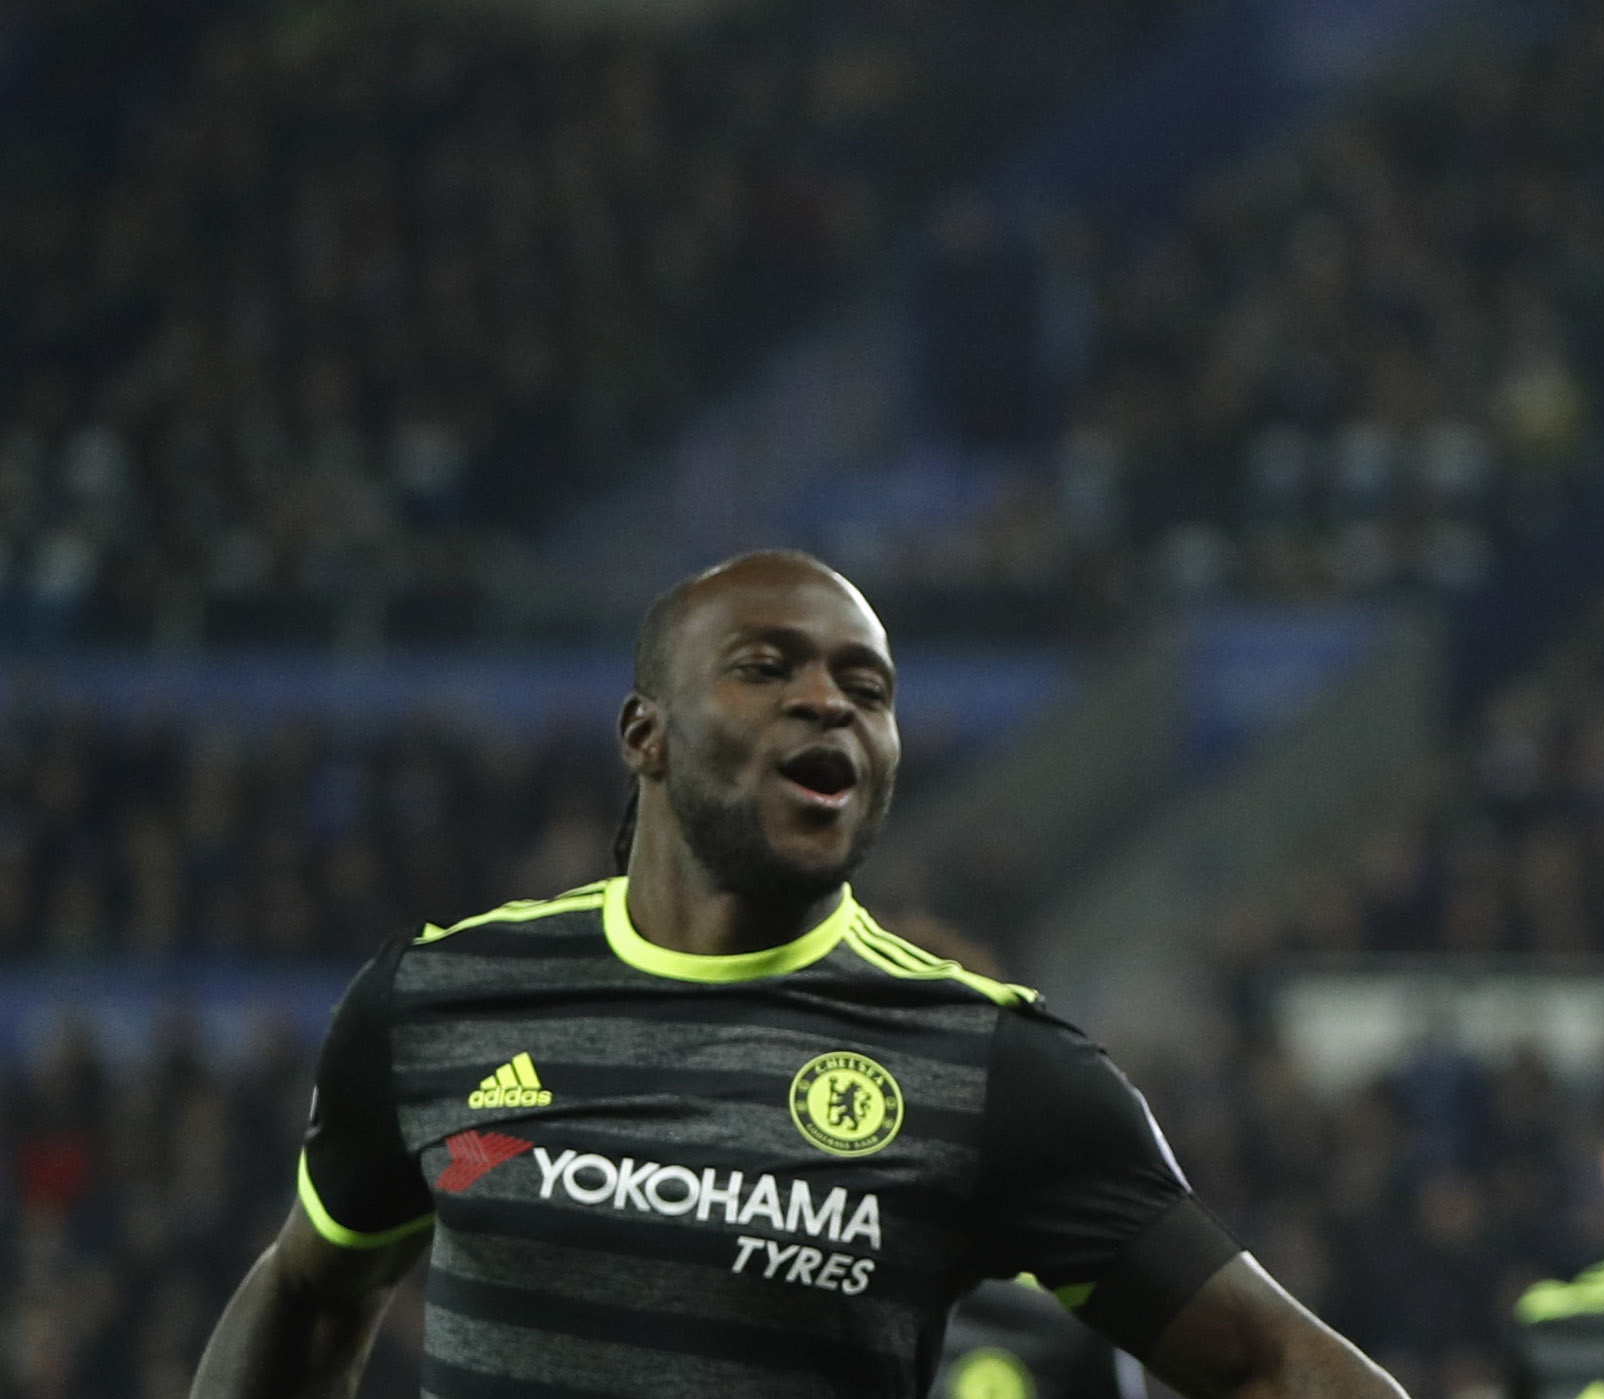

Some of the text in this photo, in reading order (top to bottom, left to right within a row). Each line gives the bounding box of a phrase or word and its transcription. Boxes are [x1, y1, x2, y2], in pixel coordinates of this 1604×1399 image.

[467, 1085, 554, 1110] adidas
[533, 1146, 882, 1250] YOKOHAMA
[731, 1235, 876, 1296] TYRES
